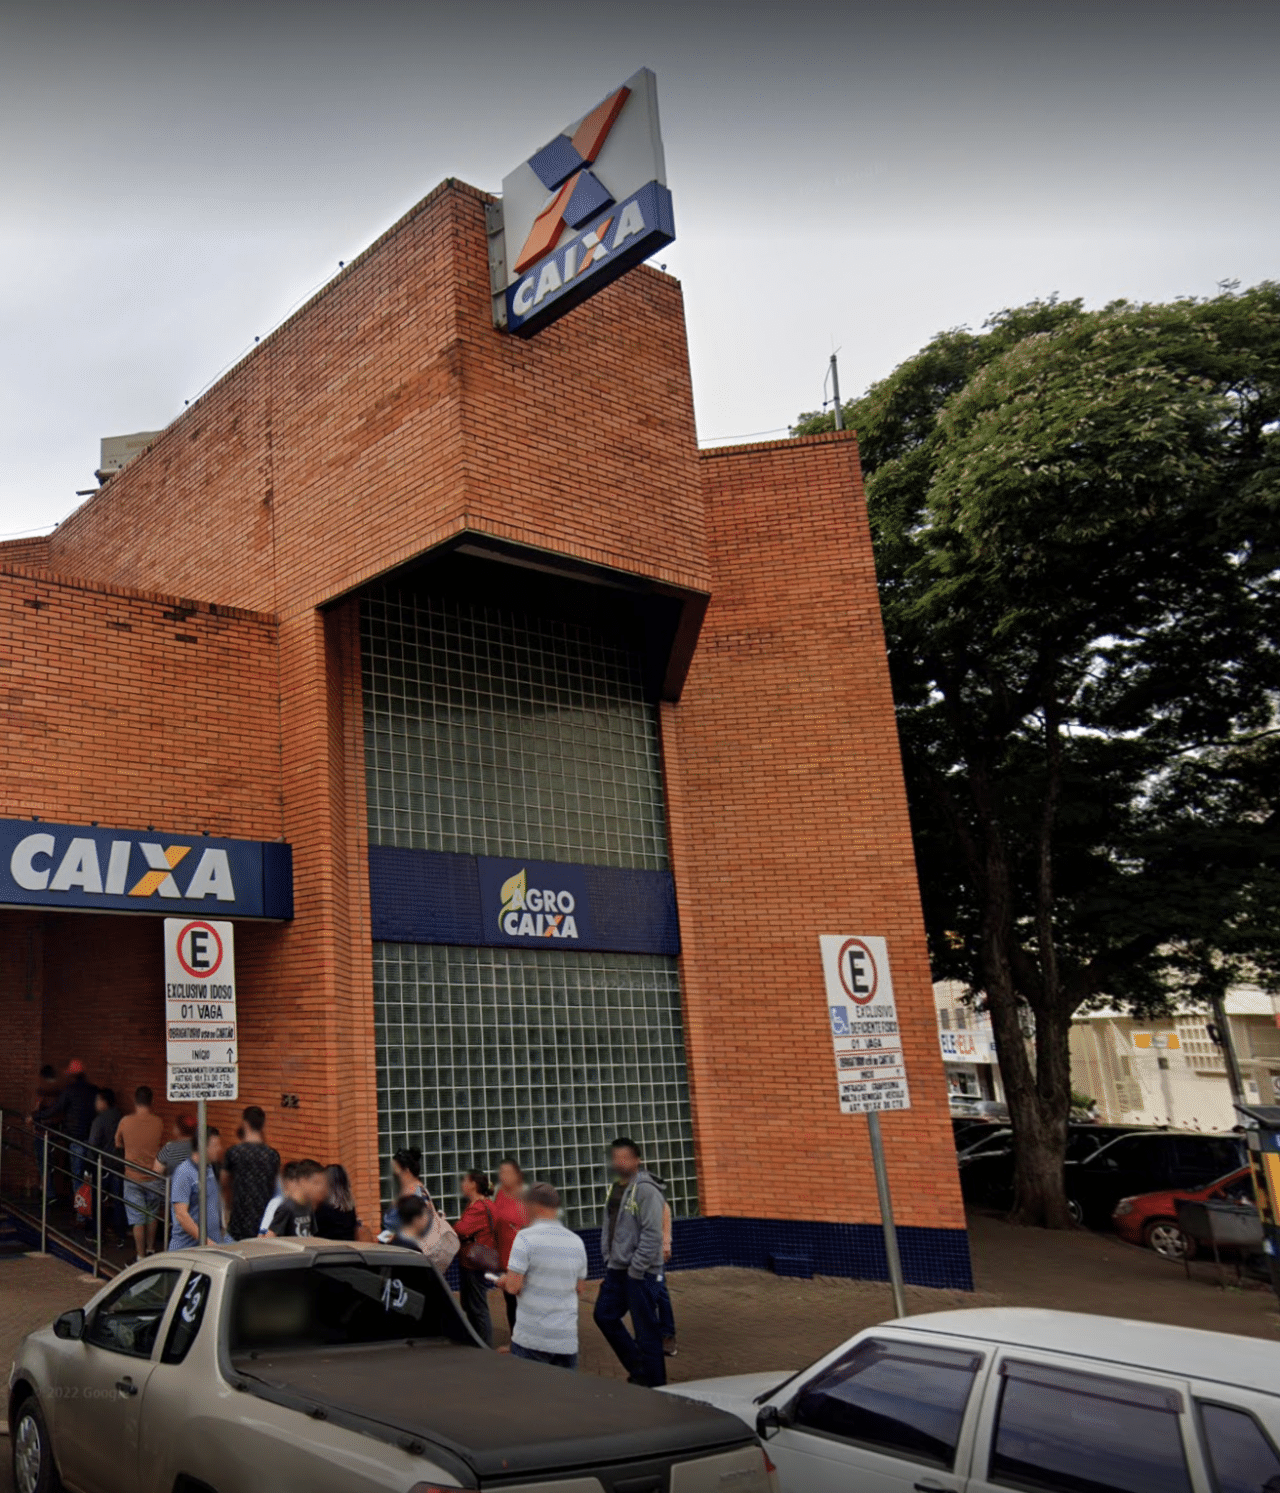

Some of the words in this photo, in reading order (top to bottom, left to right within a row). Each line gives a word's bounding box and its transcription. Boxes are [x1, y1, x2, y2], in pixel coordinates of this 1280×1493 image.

[513, 200, 646, 317] CAIXA
[10, 833, 236, 901] CAIXA
[511, 888, 575, 914] AGRO
[503, 911, 579, 939] CAIXA
[190, 930, 210, 968] E
[848, 950, 869, 993] E
[167, 983, 207, 999] EXCLUSIVO
[210, 984, 233, 1000] IDOSO
[181, 1004, 193, 1019] 01
[197, 1004, 223, 1019] VAGA
[856, 1005, 894, 1018] EXCLUSIVO
